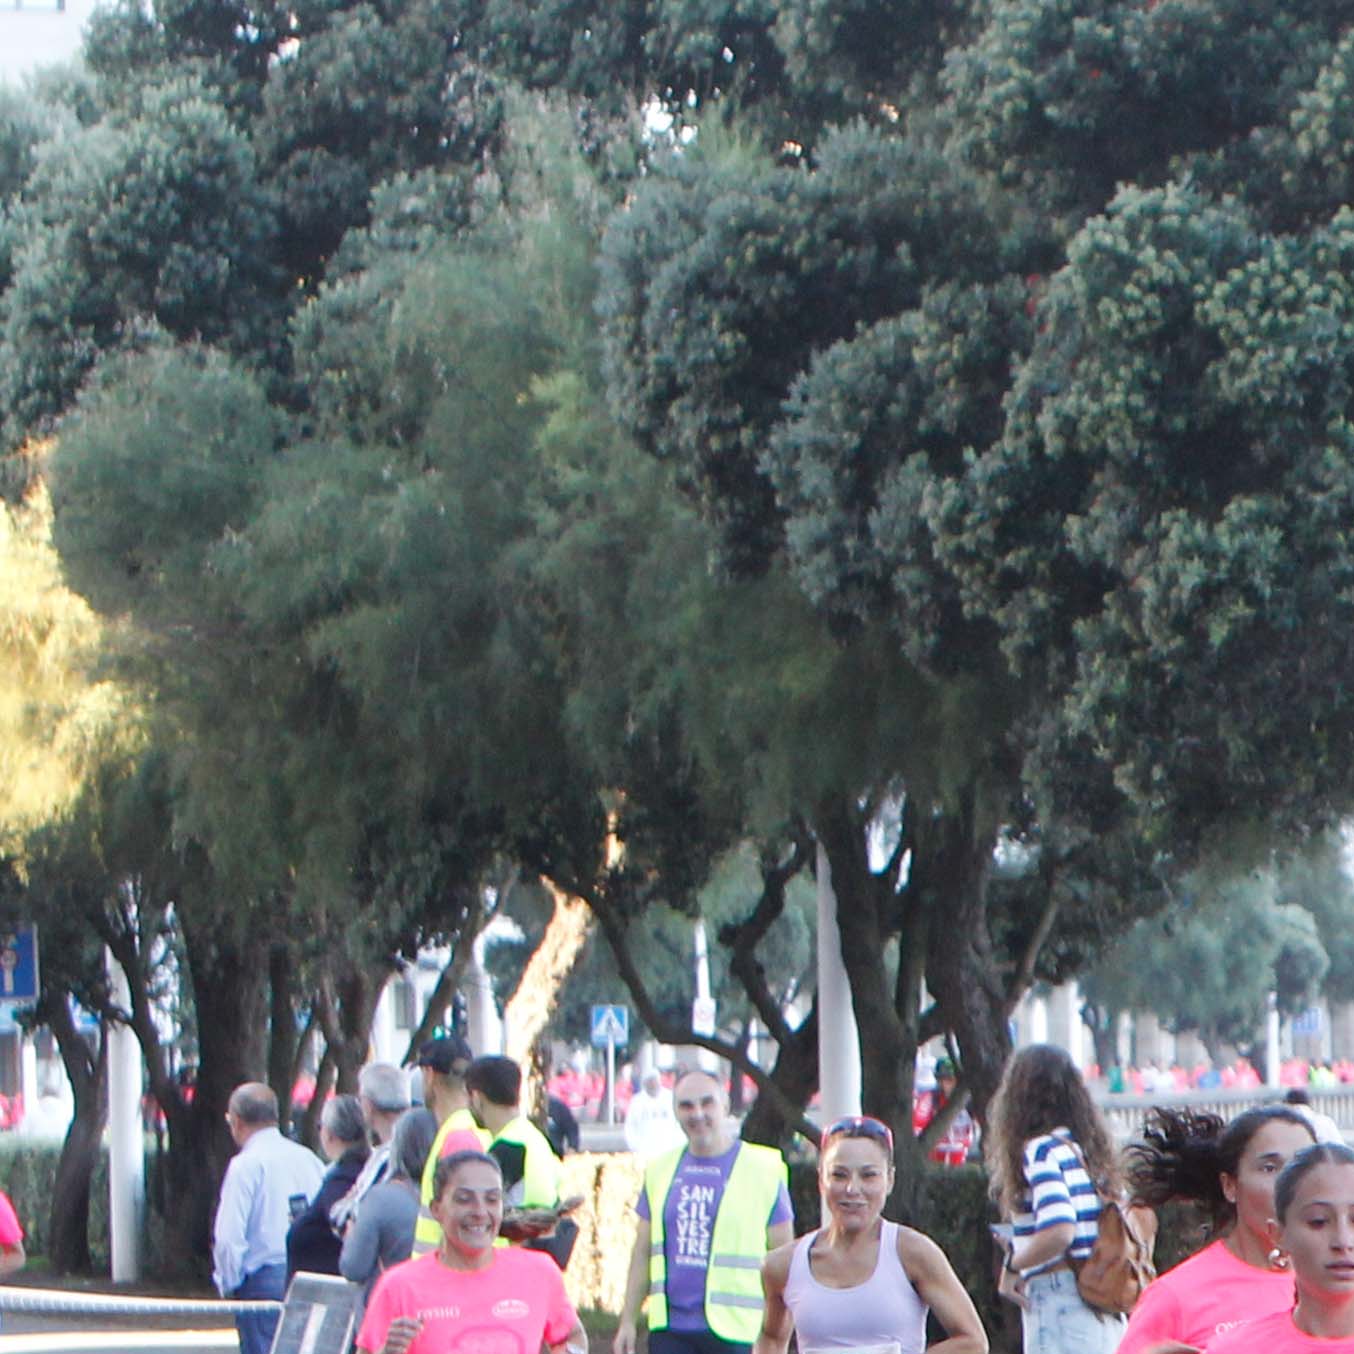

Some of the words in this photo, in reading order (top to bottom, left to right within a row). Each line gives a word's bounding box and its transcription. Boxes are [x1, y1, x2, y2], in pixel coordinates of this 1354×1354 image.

[680, 1185, 715, 1205] SAN
[677, 1202, 711, 1221] SIL
[676, 1219, 710, 1239] VES
[676, 1236, 709, 1256] TRE
